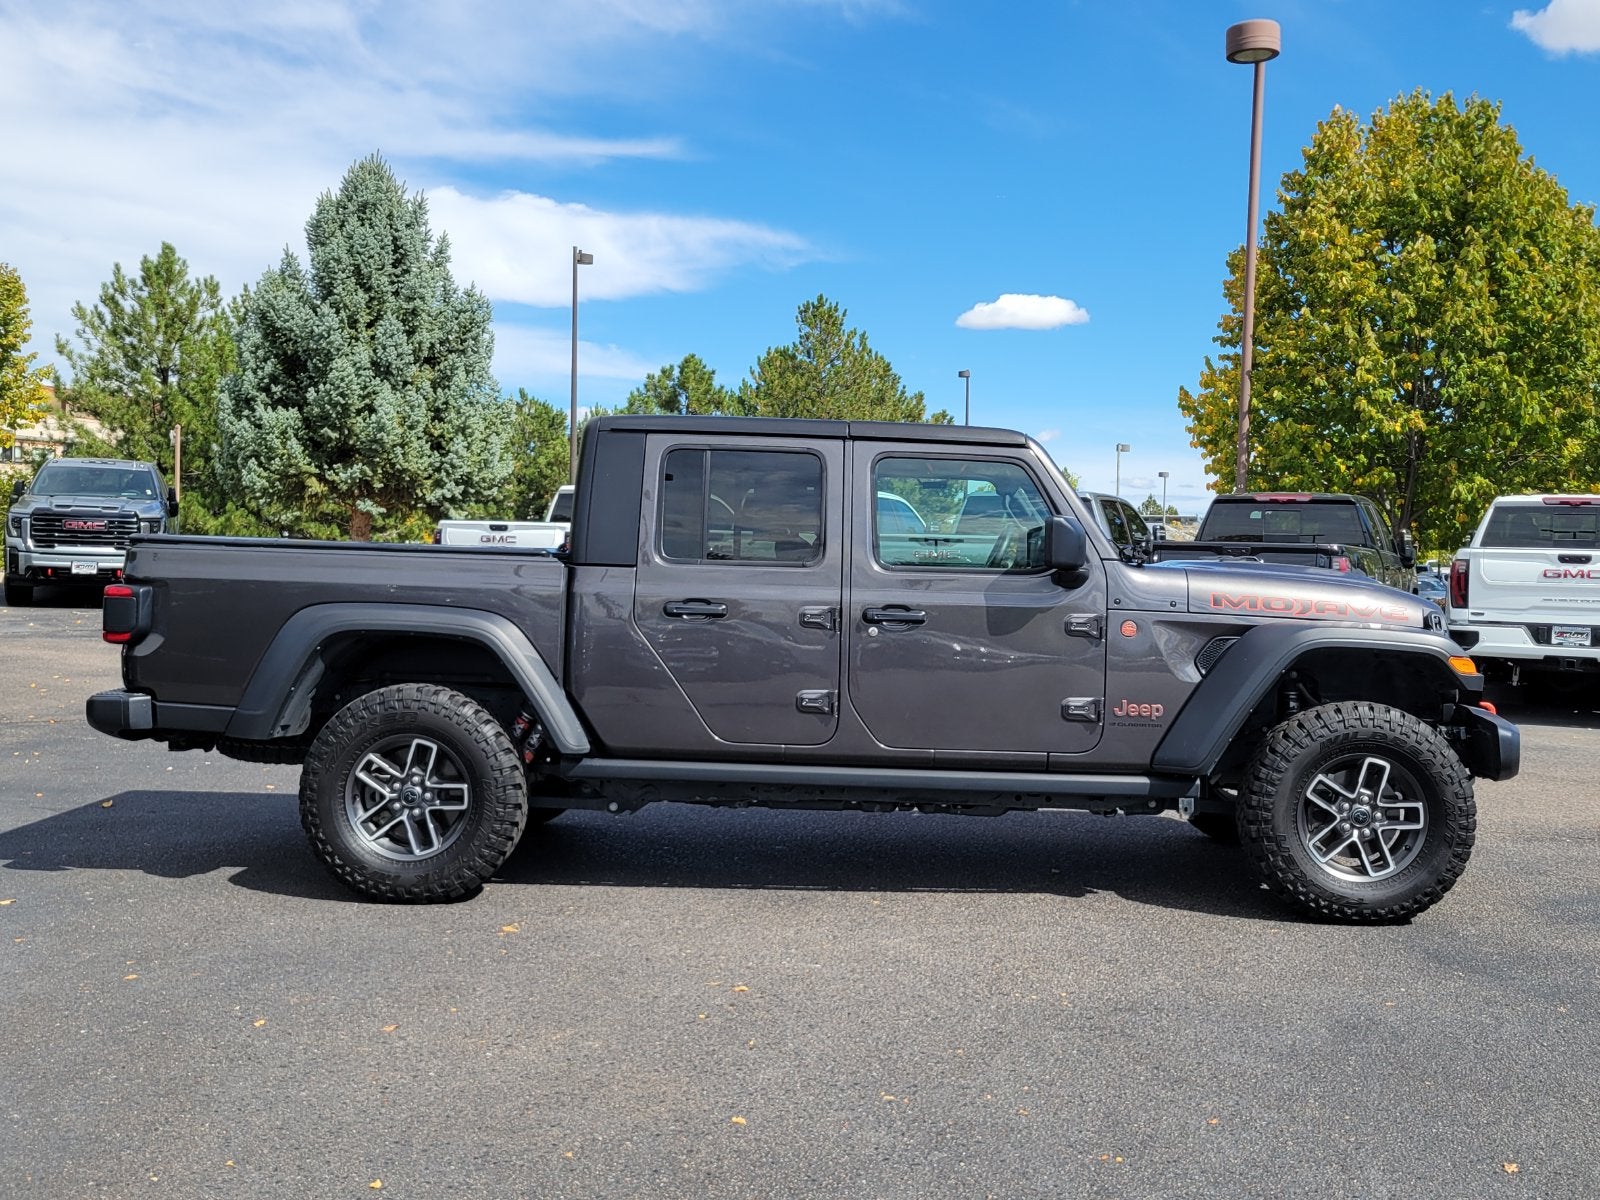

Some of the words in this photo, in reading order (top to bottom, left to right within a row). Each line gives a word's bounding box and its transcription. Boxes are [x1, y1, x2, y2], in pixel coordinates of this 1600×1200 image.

[65, 521, 106, 529] GMC
[480, 535, 517, 544] GMC
[1543, 569, 1600, 579] GMC
[1210, 592, 1409, 622] MOJAVE
[1113, 699, 1164, 720] Jeep
